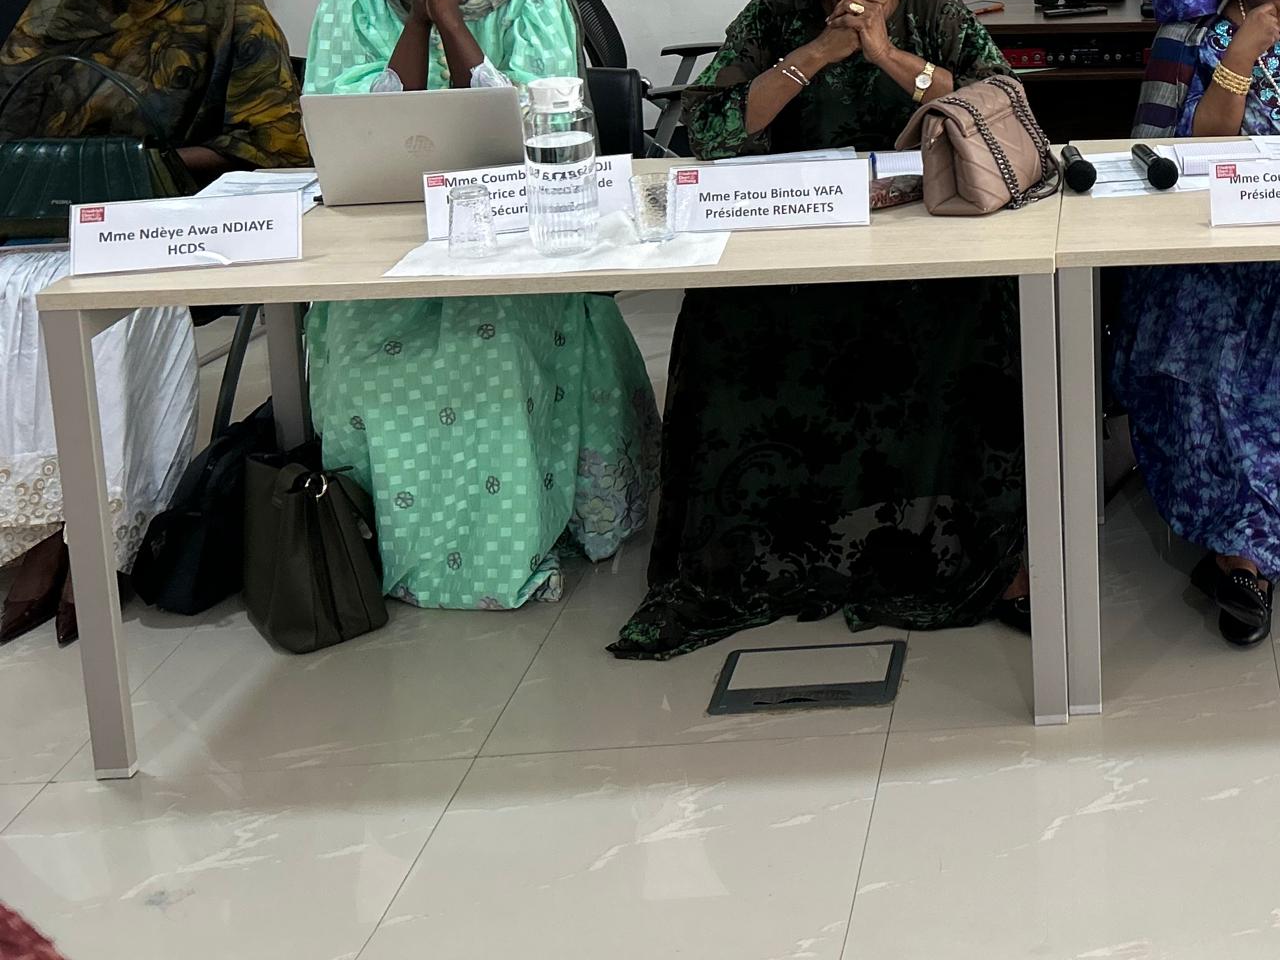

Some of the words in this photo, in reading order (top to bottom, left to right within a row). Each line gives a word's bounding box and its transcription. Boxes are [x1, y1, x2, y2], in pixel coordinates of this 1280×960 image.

[445, 176, 478, 188] Mme
[481, 171, 526, 184] Coumb
[598, 177, 613, 188] de
[1230, 173, 1260, 184] Mme
[699, 191, 731, 203] Mme
[734, 189, 767, 201] Fatou
[770, 186, 810, 198] Bintou
[813, 185, 843, 196] YAFA
[490, 200, 529, 217] Sécuri
[705, 206, 770, 219] Présidente
[773, 203, 834, 215] RENAFETS
[98, 231, 136, 243] Mme
[139, 225, 184, 241] Ndèye
[187, 224, 218, 236] Awa
[222, 219, 274, 232] NDIAYE
[167, 243, 206, 255] HCDS
